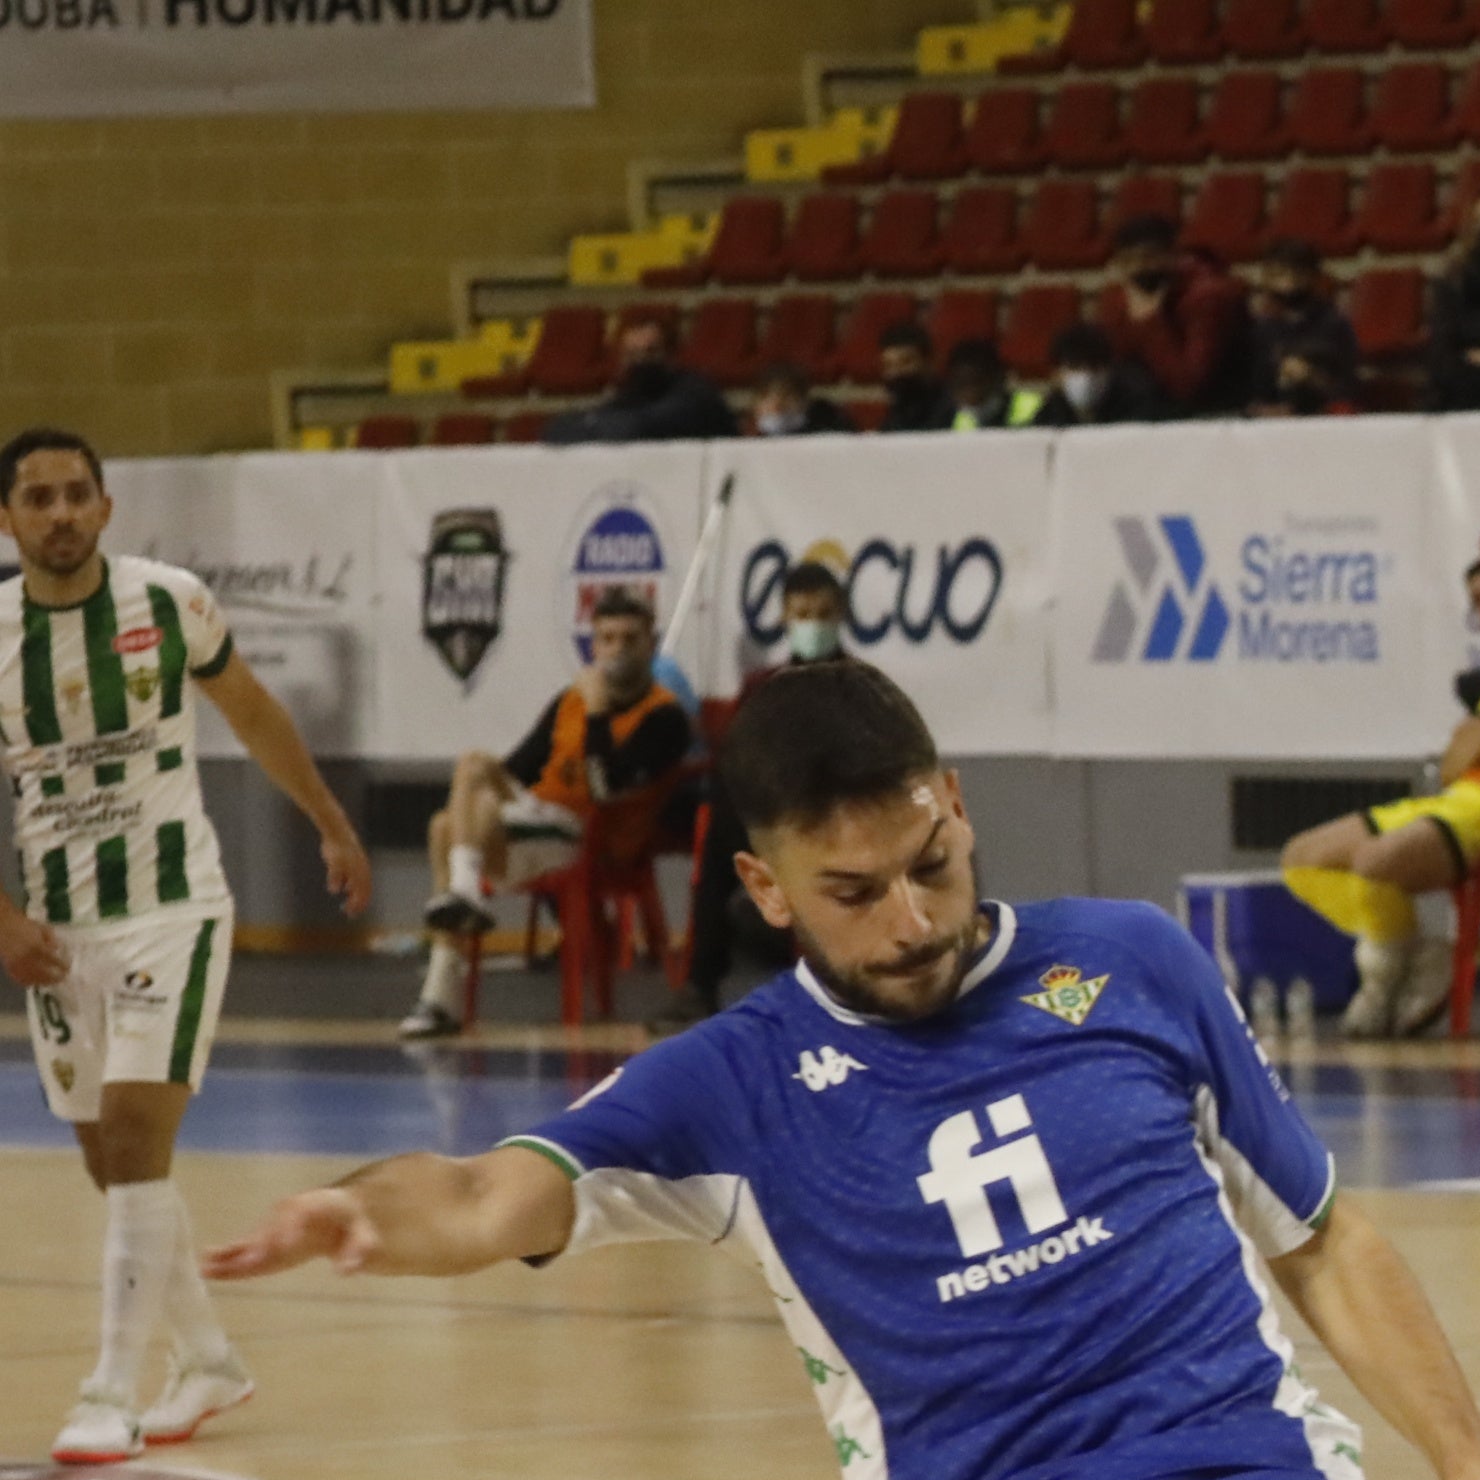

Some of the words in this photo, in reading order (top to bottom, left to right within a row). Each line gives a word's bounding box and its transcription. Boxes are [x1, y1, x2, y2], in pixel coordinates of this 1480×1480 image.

[1238, 532, 1381, 604] Sierra
[1238, 612, 1381, 664] Morena
[916, 1092, 1068, 1259] fi
[936, 1214, 1114, 1302] network
